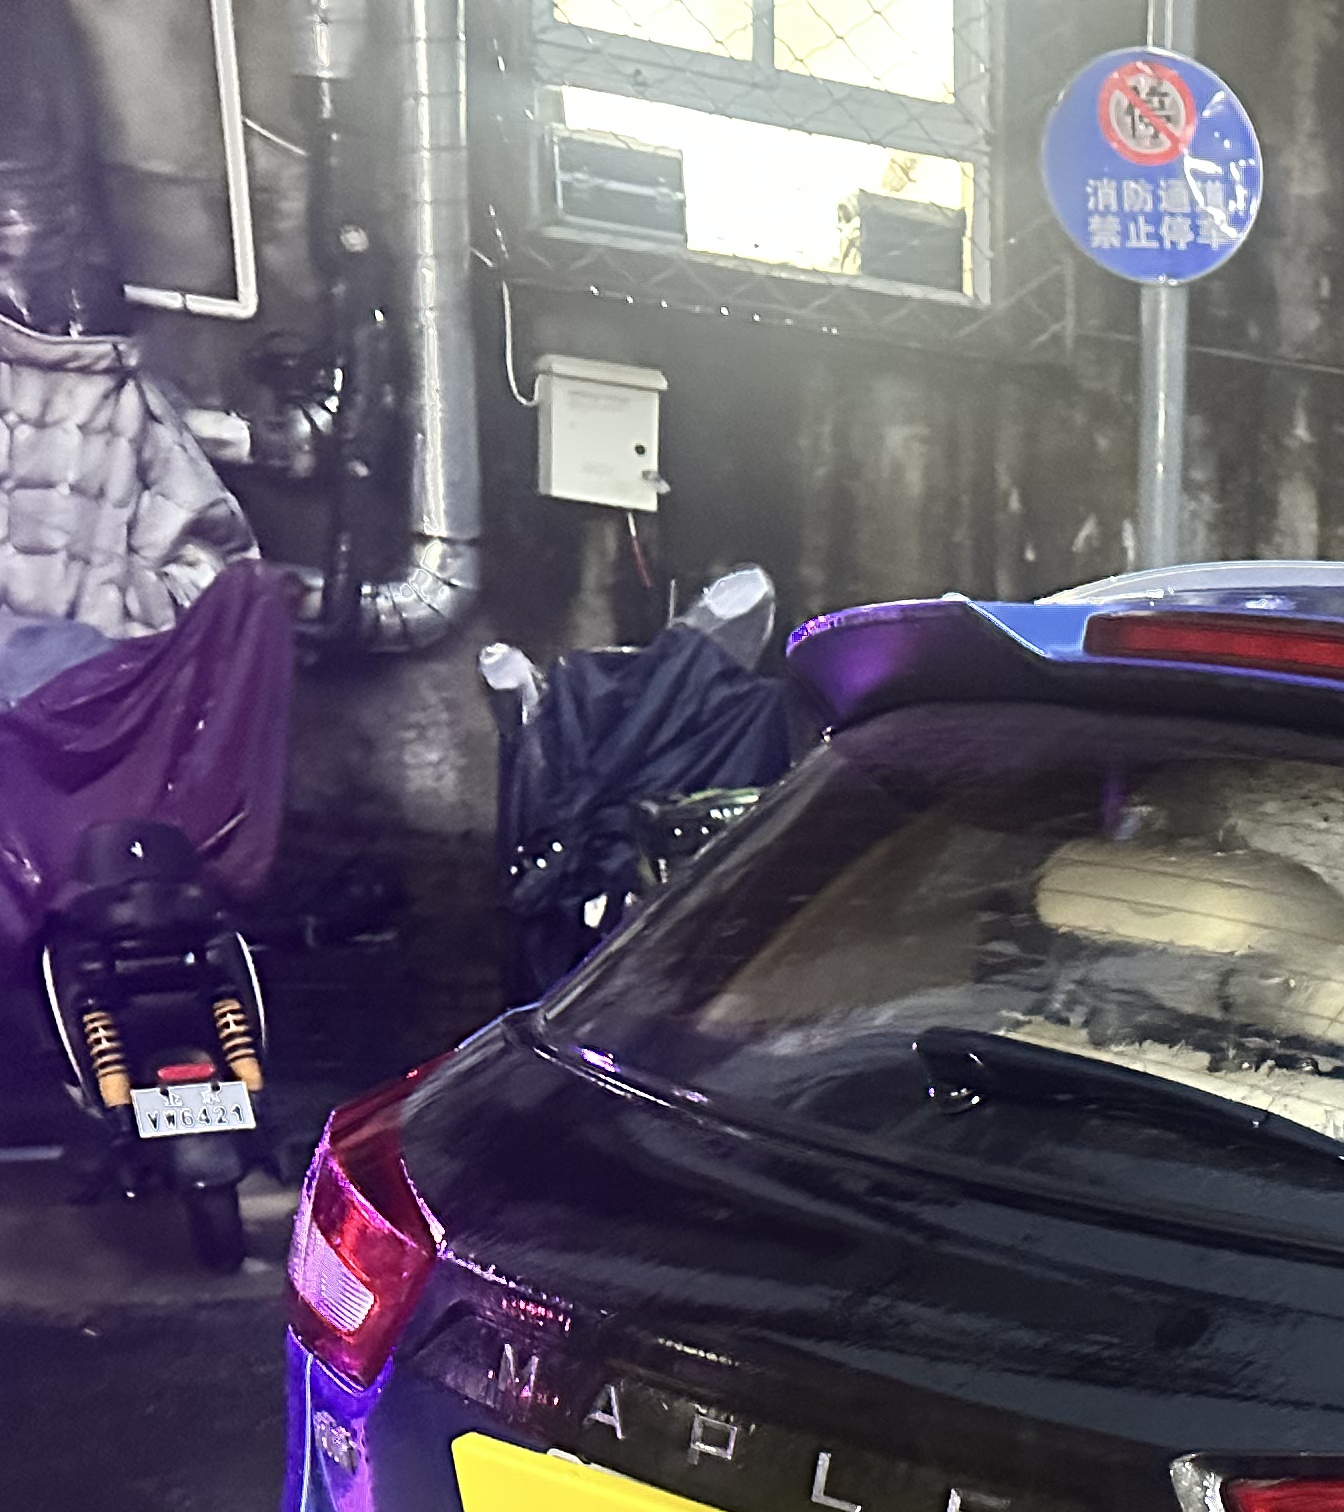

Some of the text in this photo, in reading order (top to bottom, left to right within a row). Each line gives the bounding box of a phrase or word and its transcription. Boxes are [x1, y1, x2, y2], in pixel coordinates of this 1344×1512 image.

[1085, 177, 1228, 213] 消防通道
[1087, 215, 1229, 250] 禁止停车
